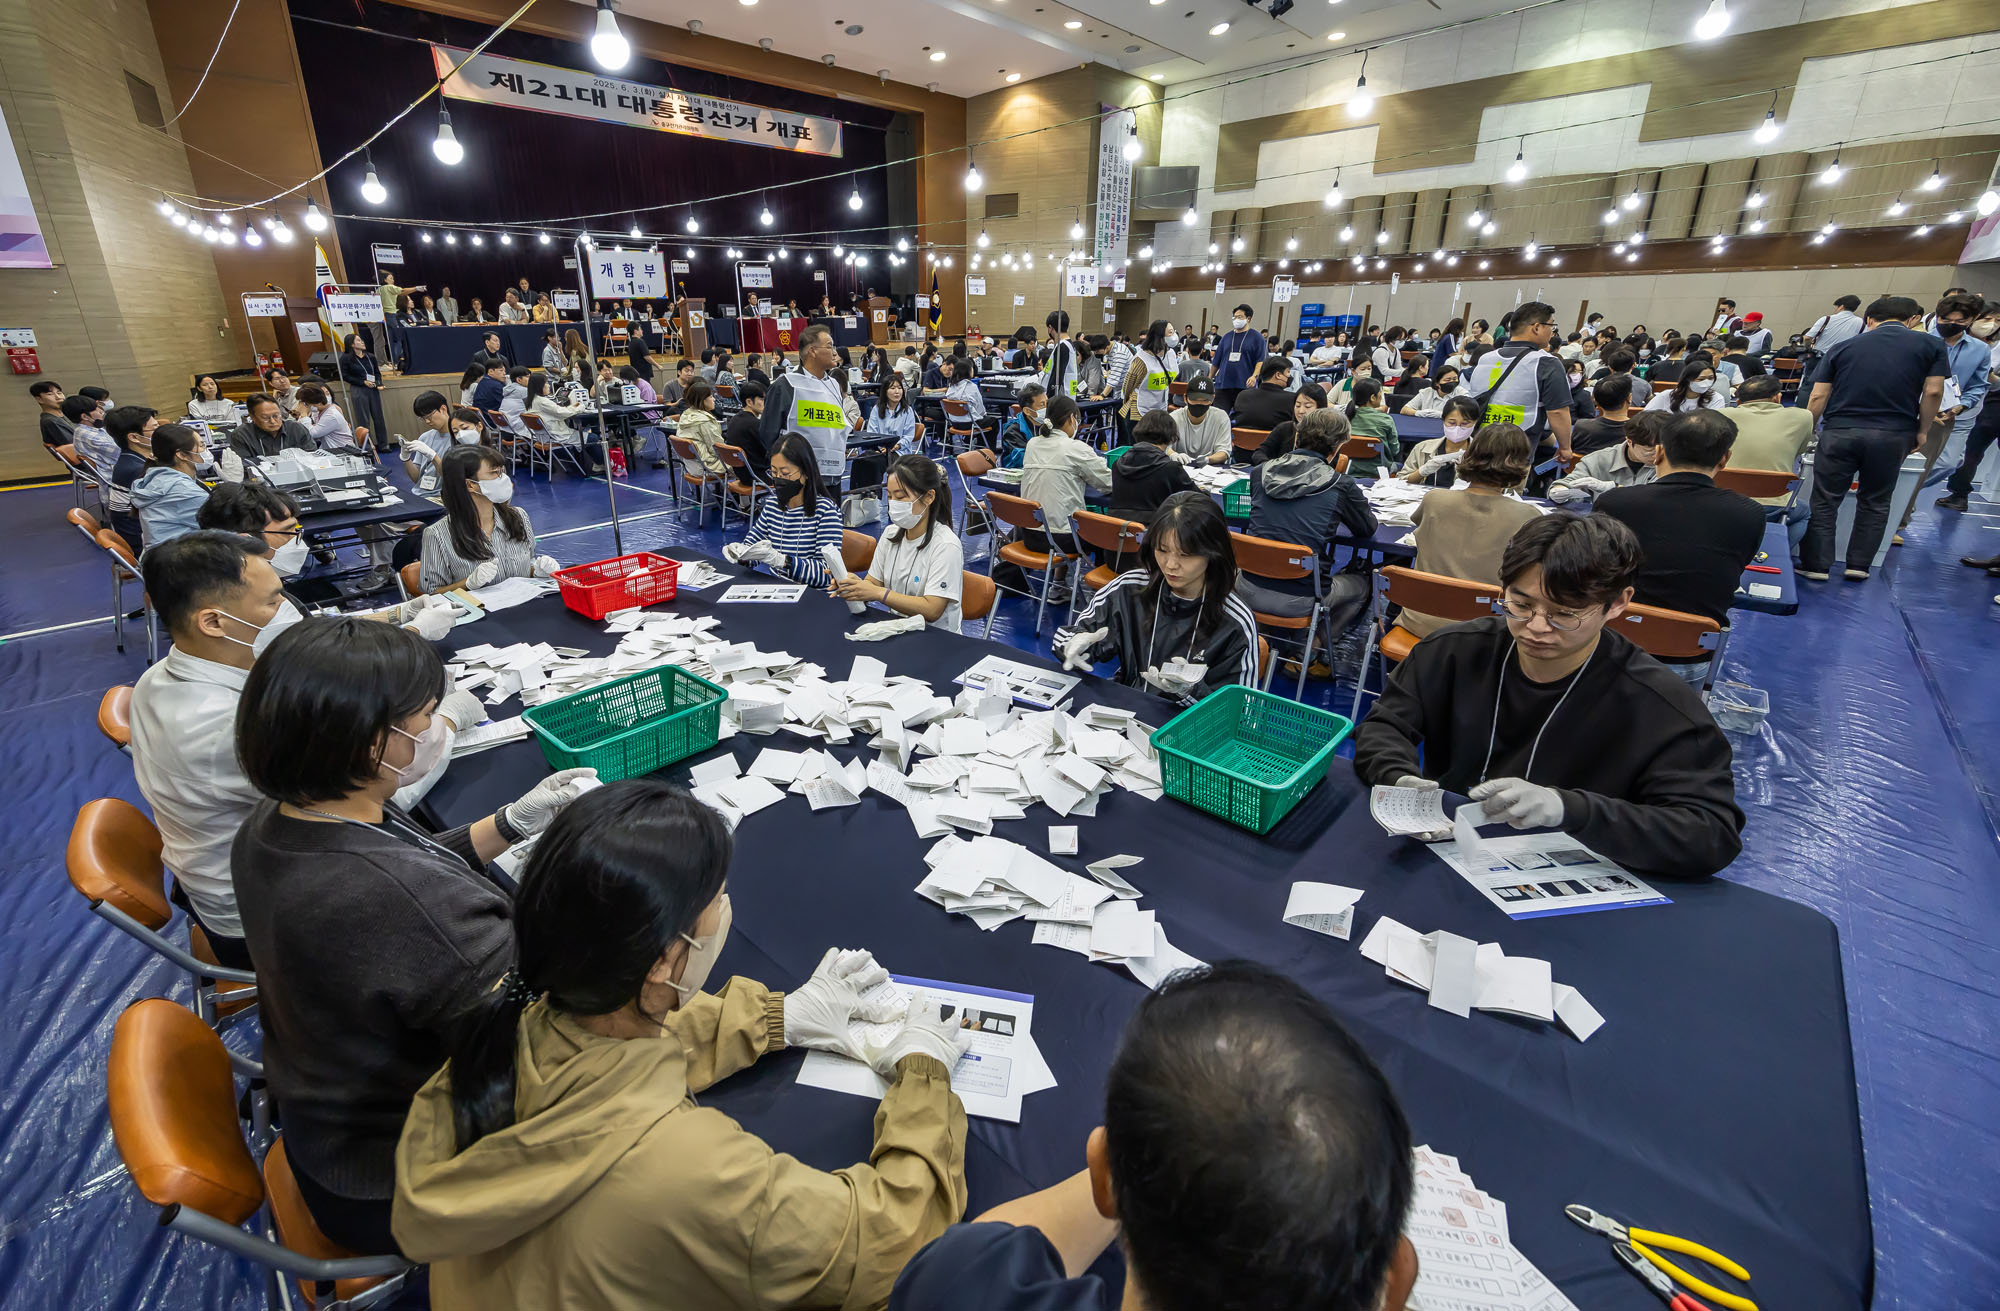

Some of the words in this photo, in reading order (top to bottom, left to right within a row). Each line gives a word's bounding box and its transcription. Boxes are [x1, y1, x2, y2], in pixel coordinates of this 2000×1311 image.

[488, 71, 607, 109] 제21대
[617, 94, 758, 134] 대통령선거
[766, 121, 813, 141] 개표
[593, 78, 618, 90] 2025.
[677, 94, 701, 105] 제21대
[704, 99, 740, 112] 대통령선거
[600, 262, 656, 279] 개함부
[1071, 274, 1095, 284] 개함부
